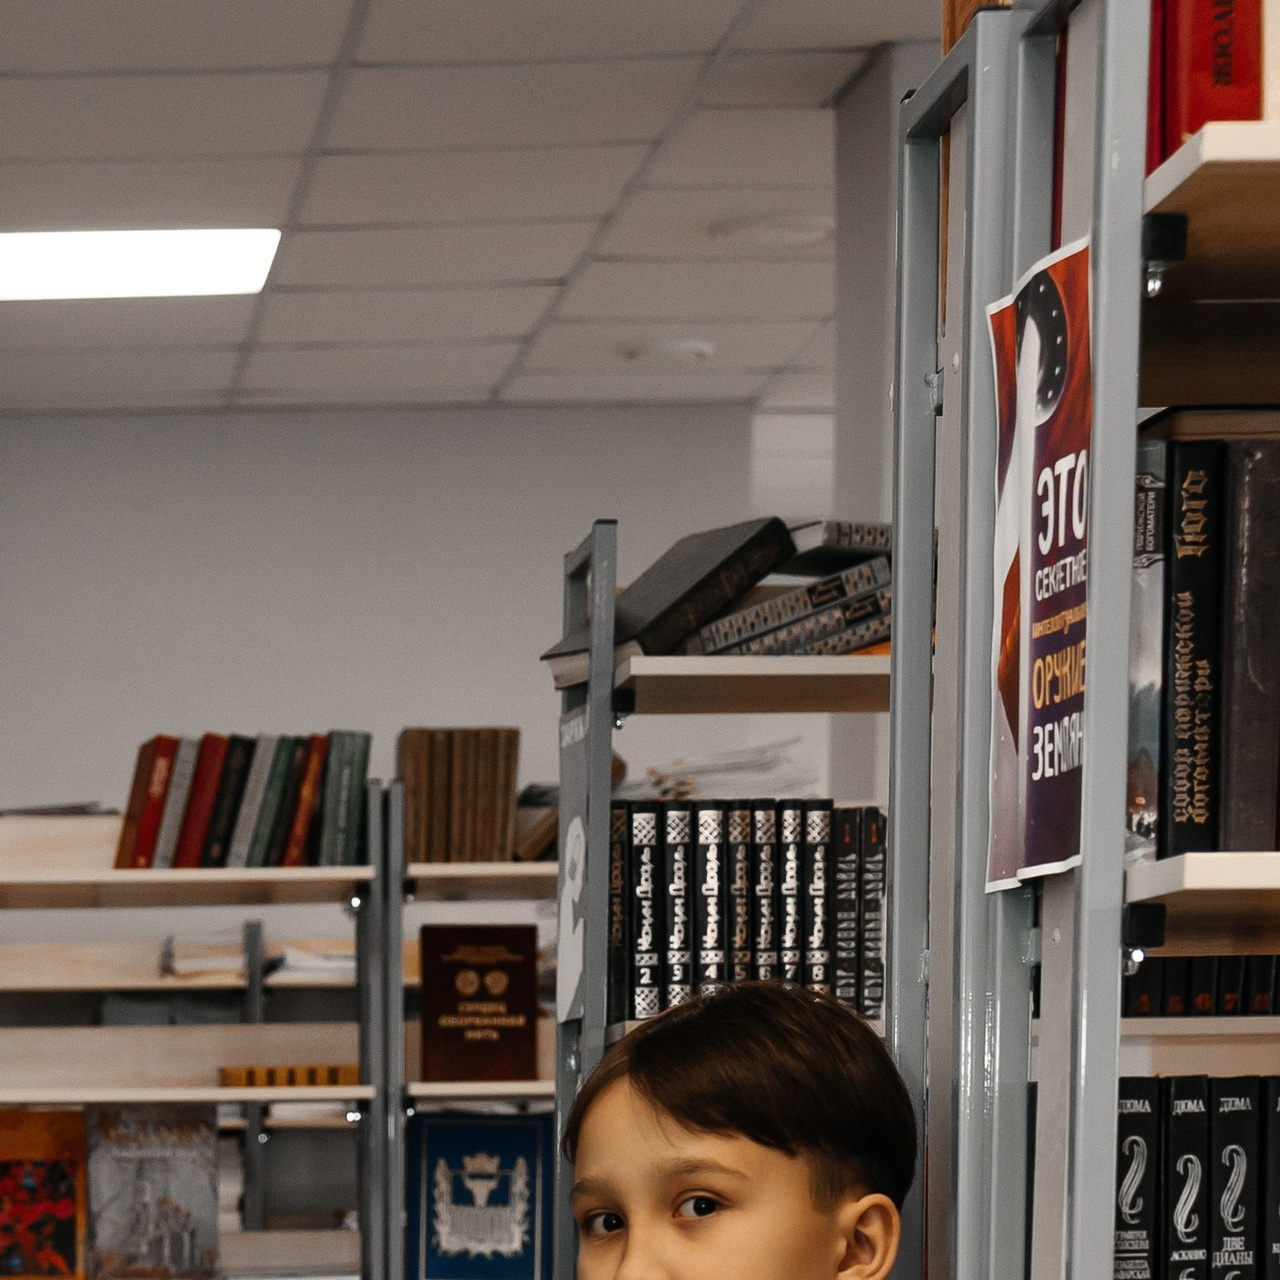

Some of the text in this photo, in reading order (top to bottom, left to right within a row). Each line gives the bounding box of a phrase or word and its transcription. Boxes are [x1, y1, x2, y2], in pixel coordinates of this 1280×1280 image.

[1036, 449, 1089, 556] ЭТО
[639, 968, 652, 984] 2
[672, 965, 683, 981] 3
[705, 964, 718, 979] 4
[785, 964, 797, 979] 7
[812, 965, 825, 980] 8
[1172, 1099, 1206, 1116] ДЮМА
[1219, 1097, 1252, 1113] ДЮМА
[1222, 1236, 1245, 1251] ДВЕ
[1211, 1250, 1254, 1269] ДИАНЫ
